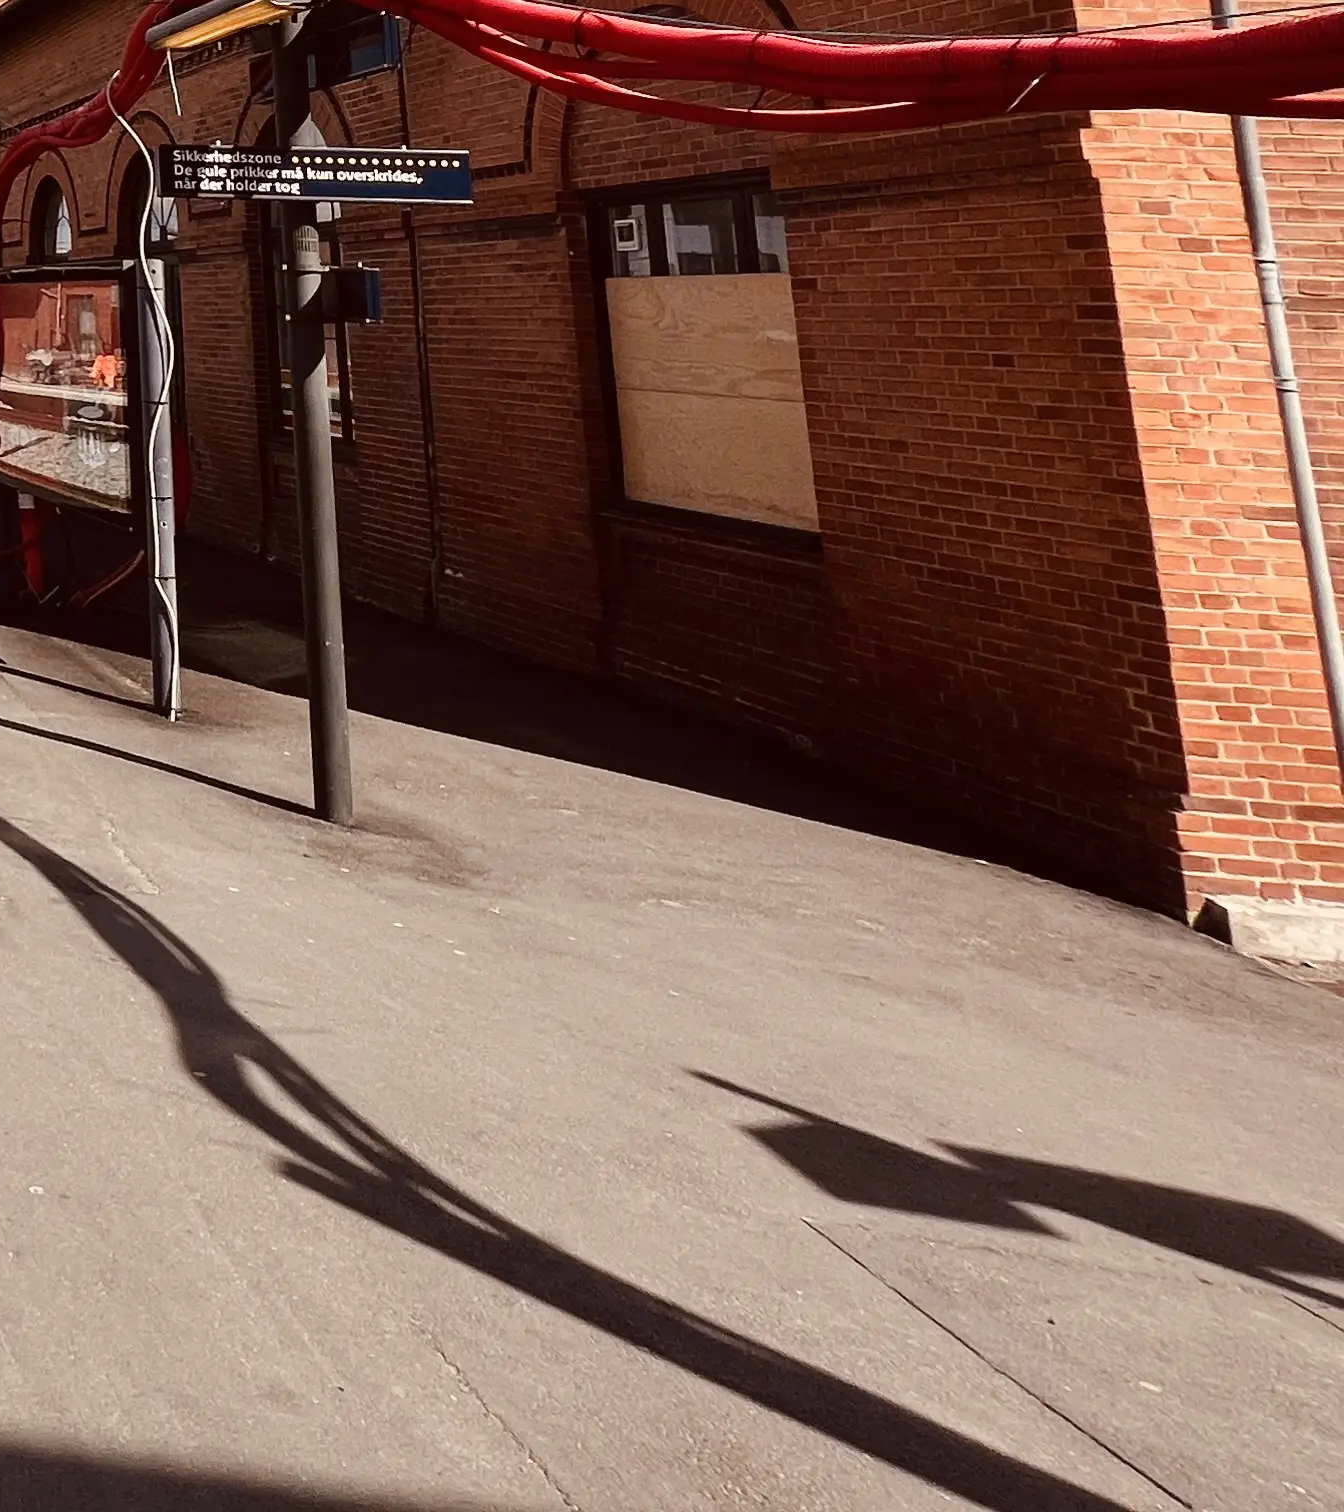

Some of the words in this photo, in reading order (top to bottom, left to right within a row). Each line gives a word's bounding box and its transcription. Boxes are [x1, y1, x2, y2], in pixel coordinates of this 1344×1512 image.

[173, 150, 282, 164] Sikkerhedszone
[174, 164, 193, 176] De
[197, 165, 228, 179] gule
[230, 166, 279, 180] prikker
[281, 166, 304, 180] må
[306, 167, 334, 181] kun
[174, 177, 197, 190] når
[199, 178, 224, 191] der
[226, 178, 272, 192] holder
[274, 181, 301, 195] tog
